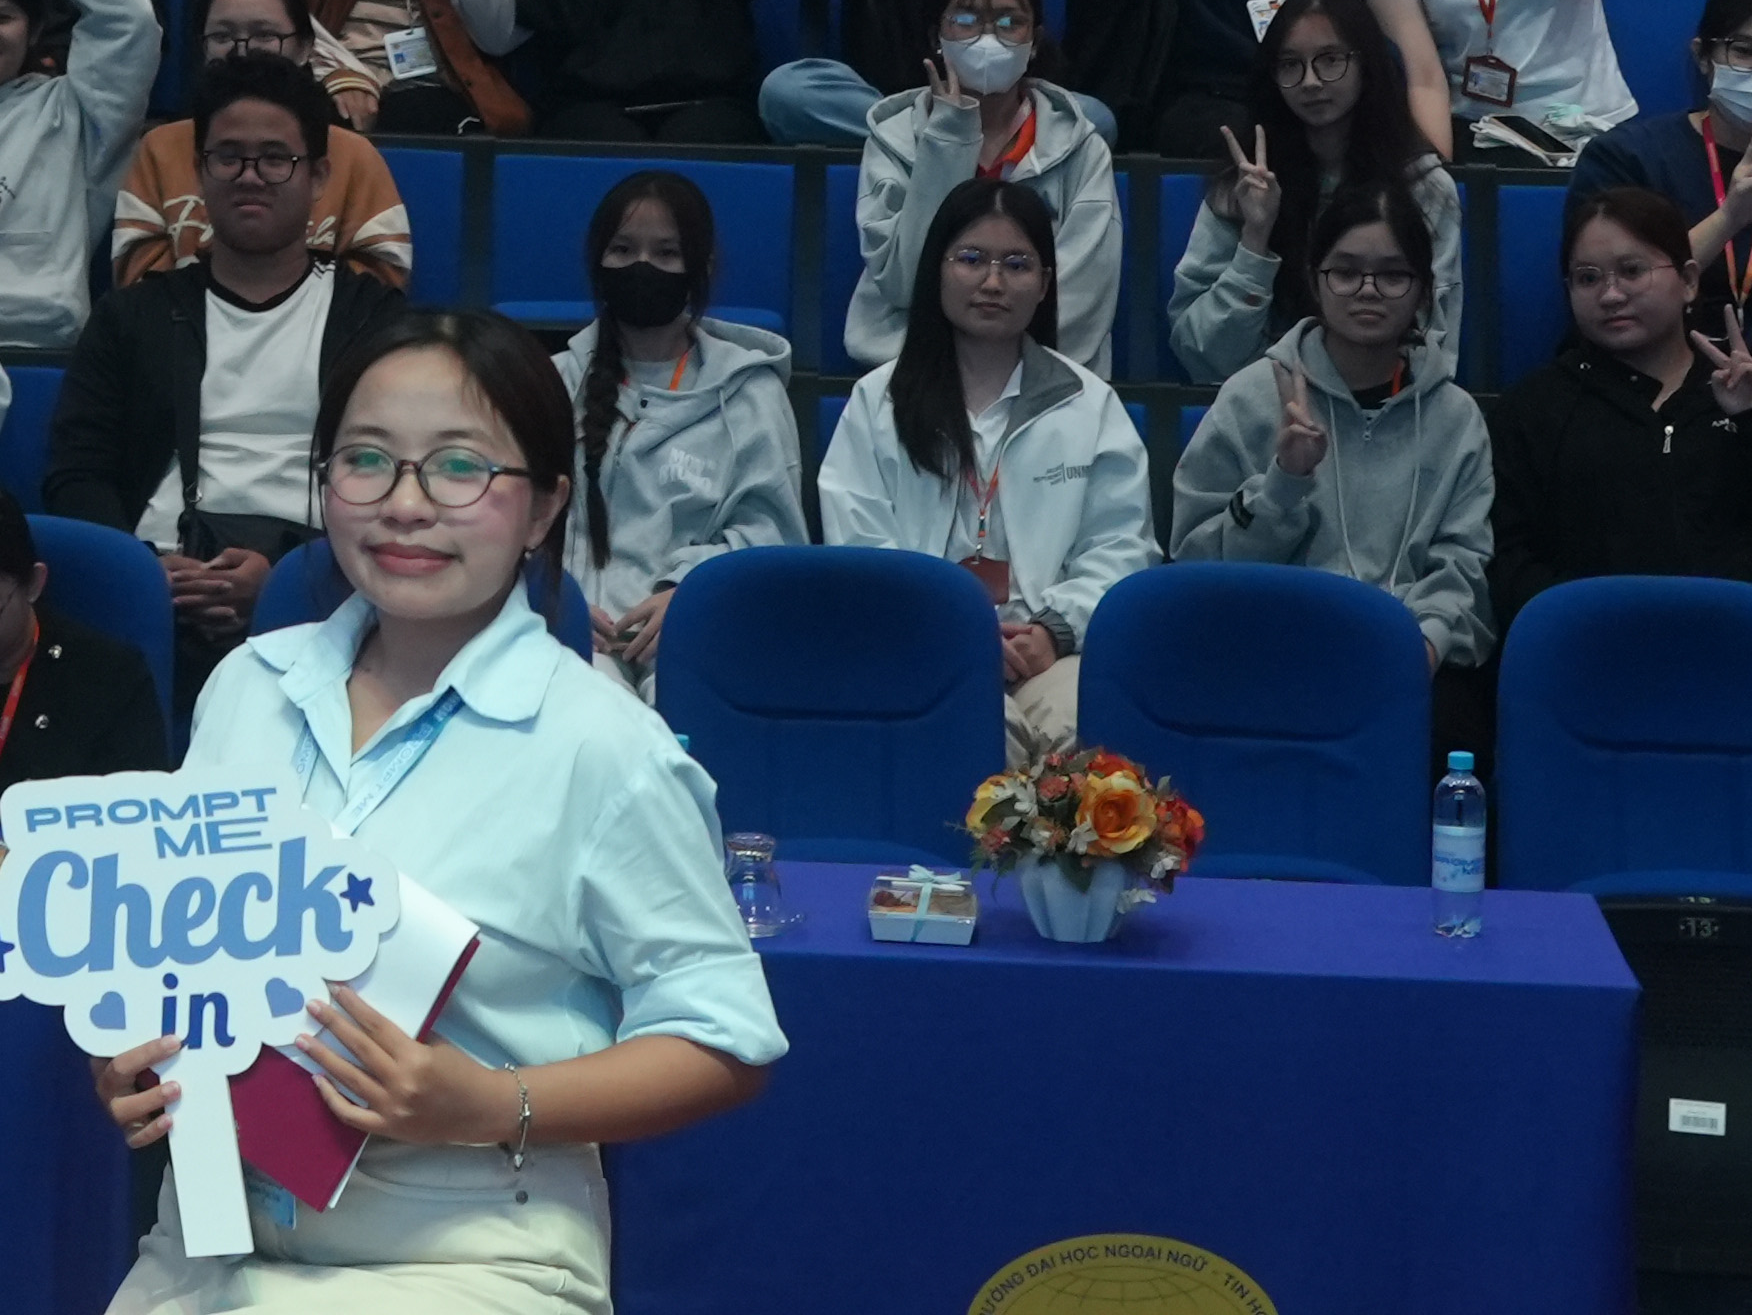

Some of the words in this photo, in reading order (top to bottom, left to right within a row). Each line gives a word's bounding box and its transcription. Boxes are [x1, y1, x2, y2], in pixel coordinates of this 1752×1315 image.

[25, 787, 277, 833] PROMPT
[153, 815, 275, 860] ME
[17, 836, 354, 978] Check
[159, 972, 237, 1051] in
[1058, 1244, 1099, 1266] HỌC
[1221, 1272, 1251, 1301] TIN
